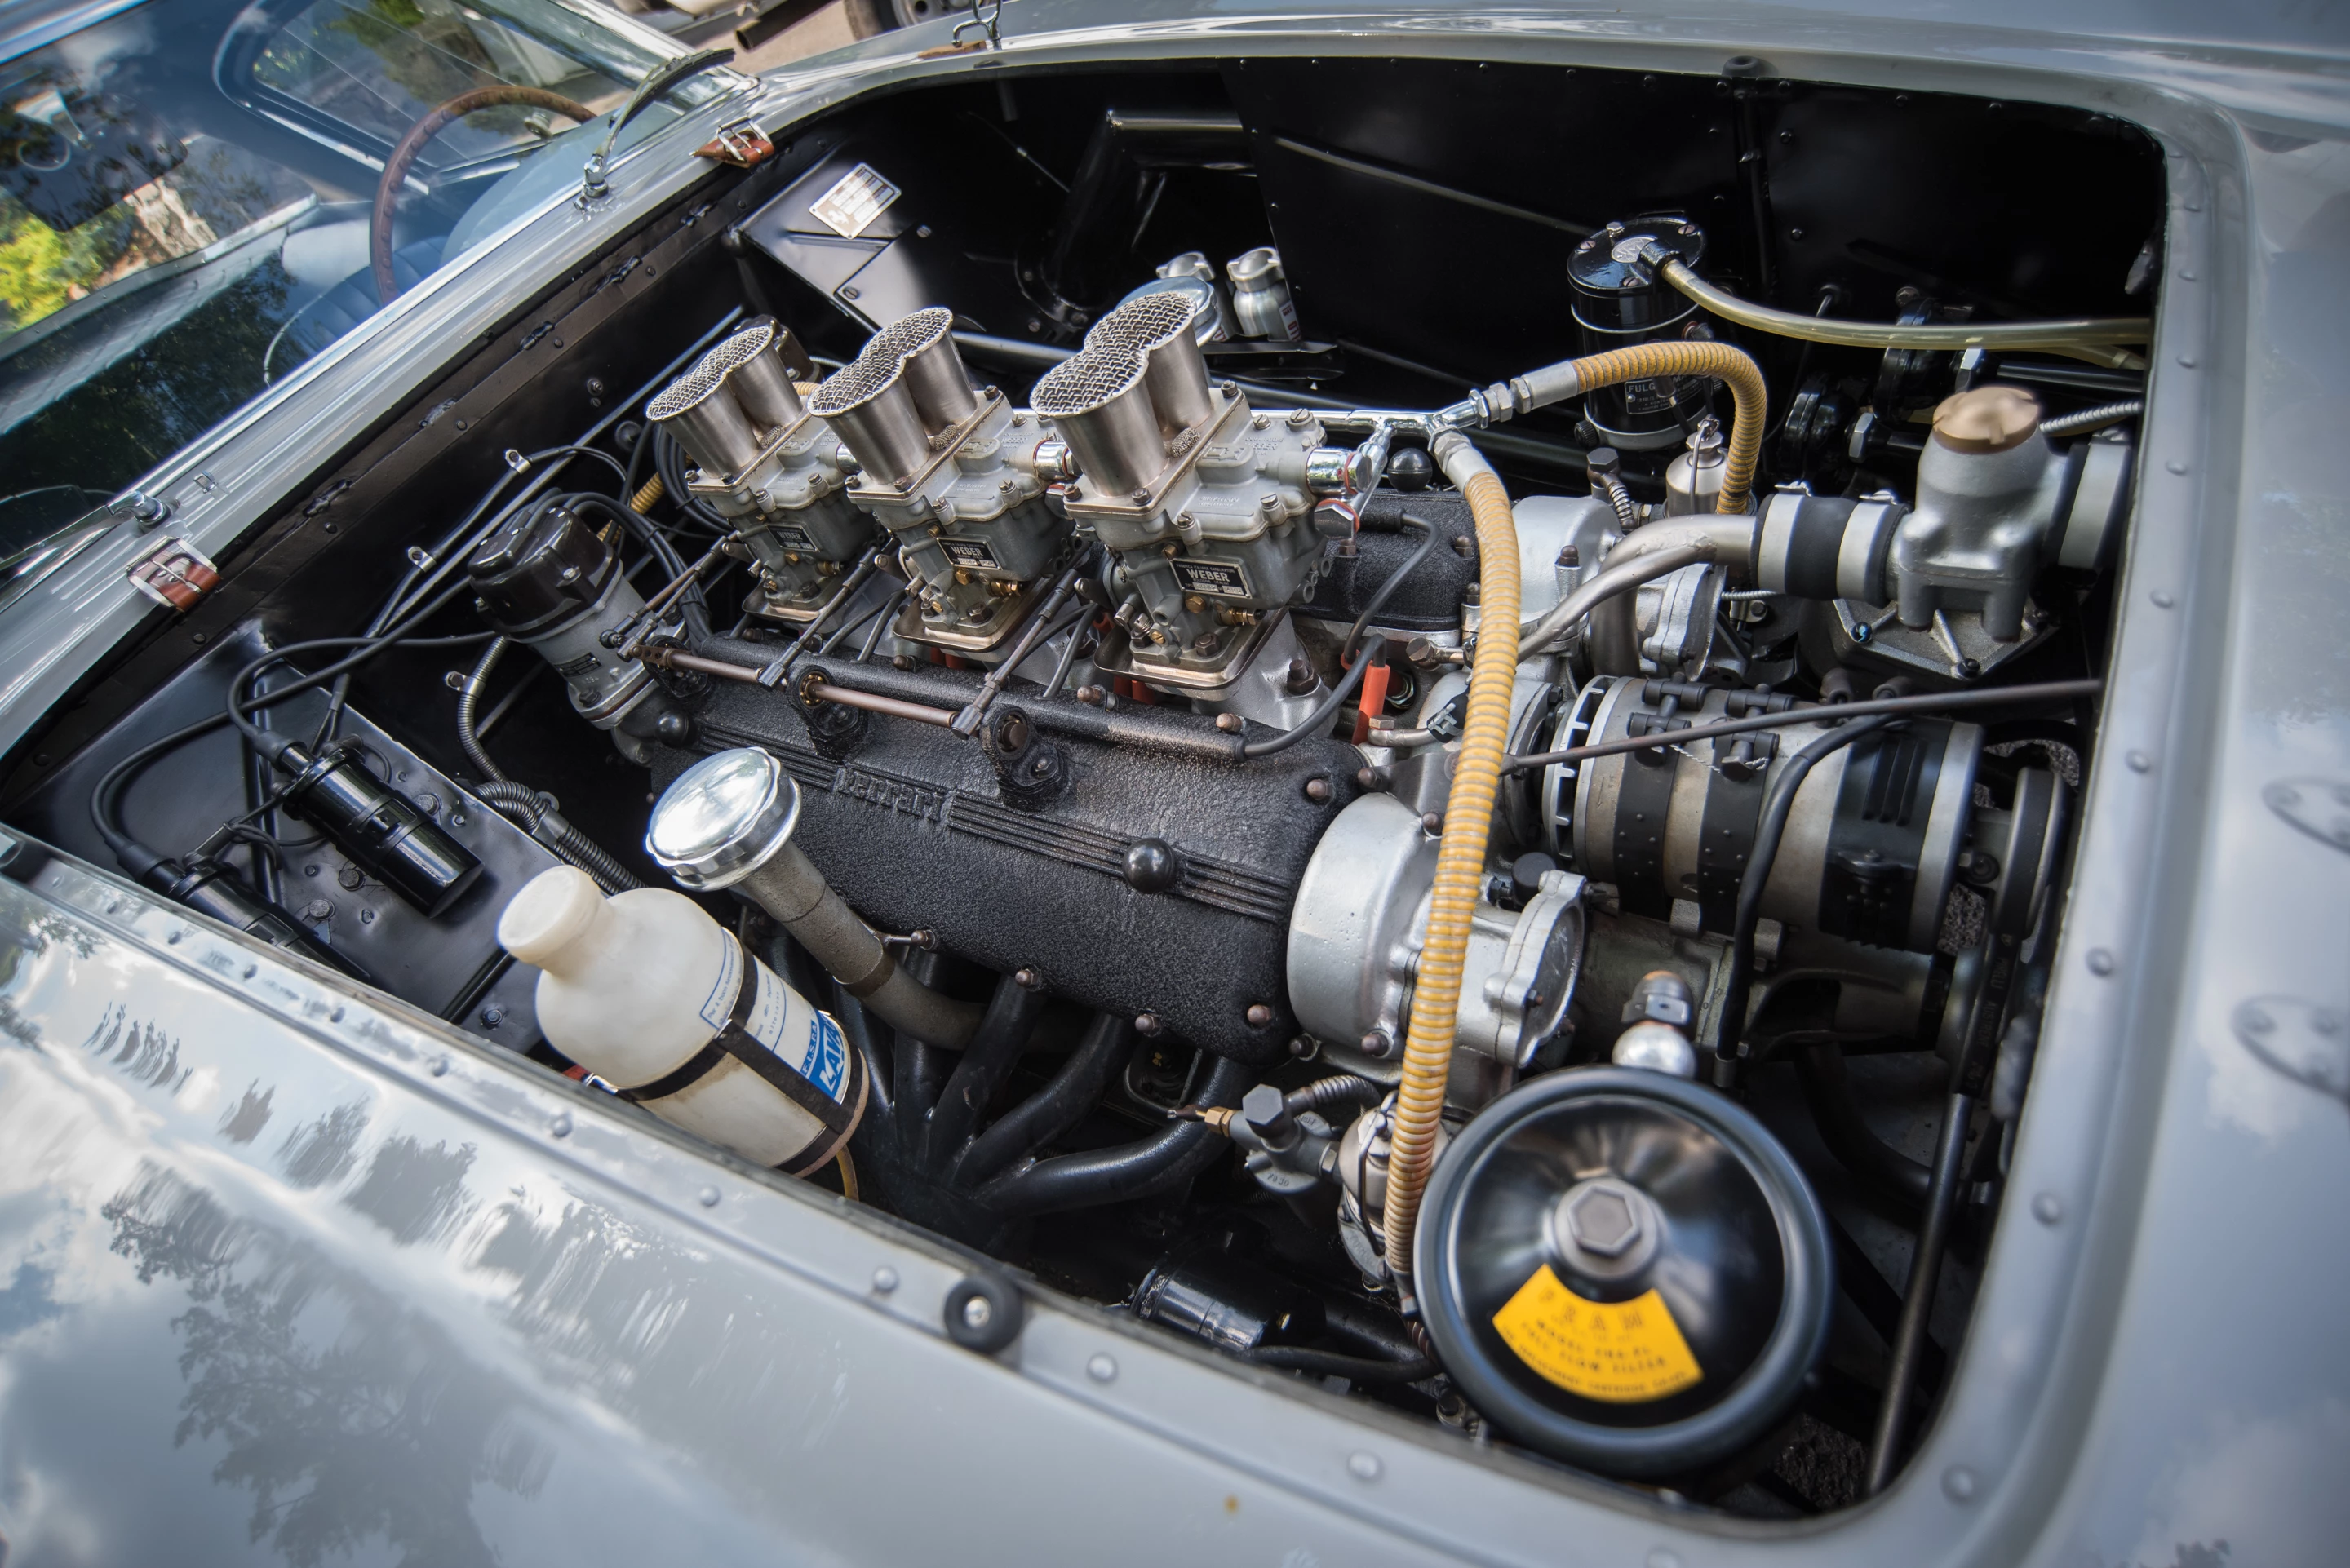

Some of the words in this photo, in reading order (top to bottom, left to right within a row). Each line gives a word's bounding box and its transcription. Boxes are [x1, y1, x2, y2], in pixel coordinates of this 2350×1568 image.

[1628, 382, 1656, 392] FULG
[776, 531, 803, 540] WEBER
[950, 546, 984, 556] WEBER
[1186, 568, 1230, 582] WEBER
[837, 763, 945, 822] Ferrari
